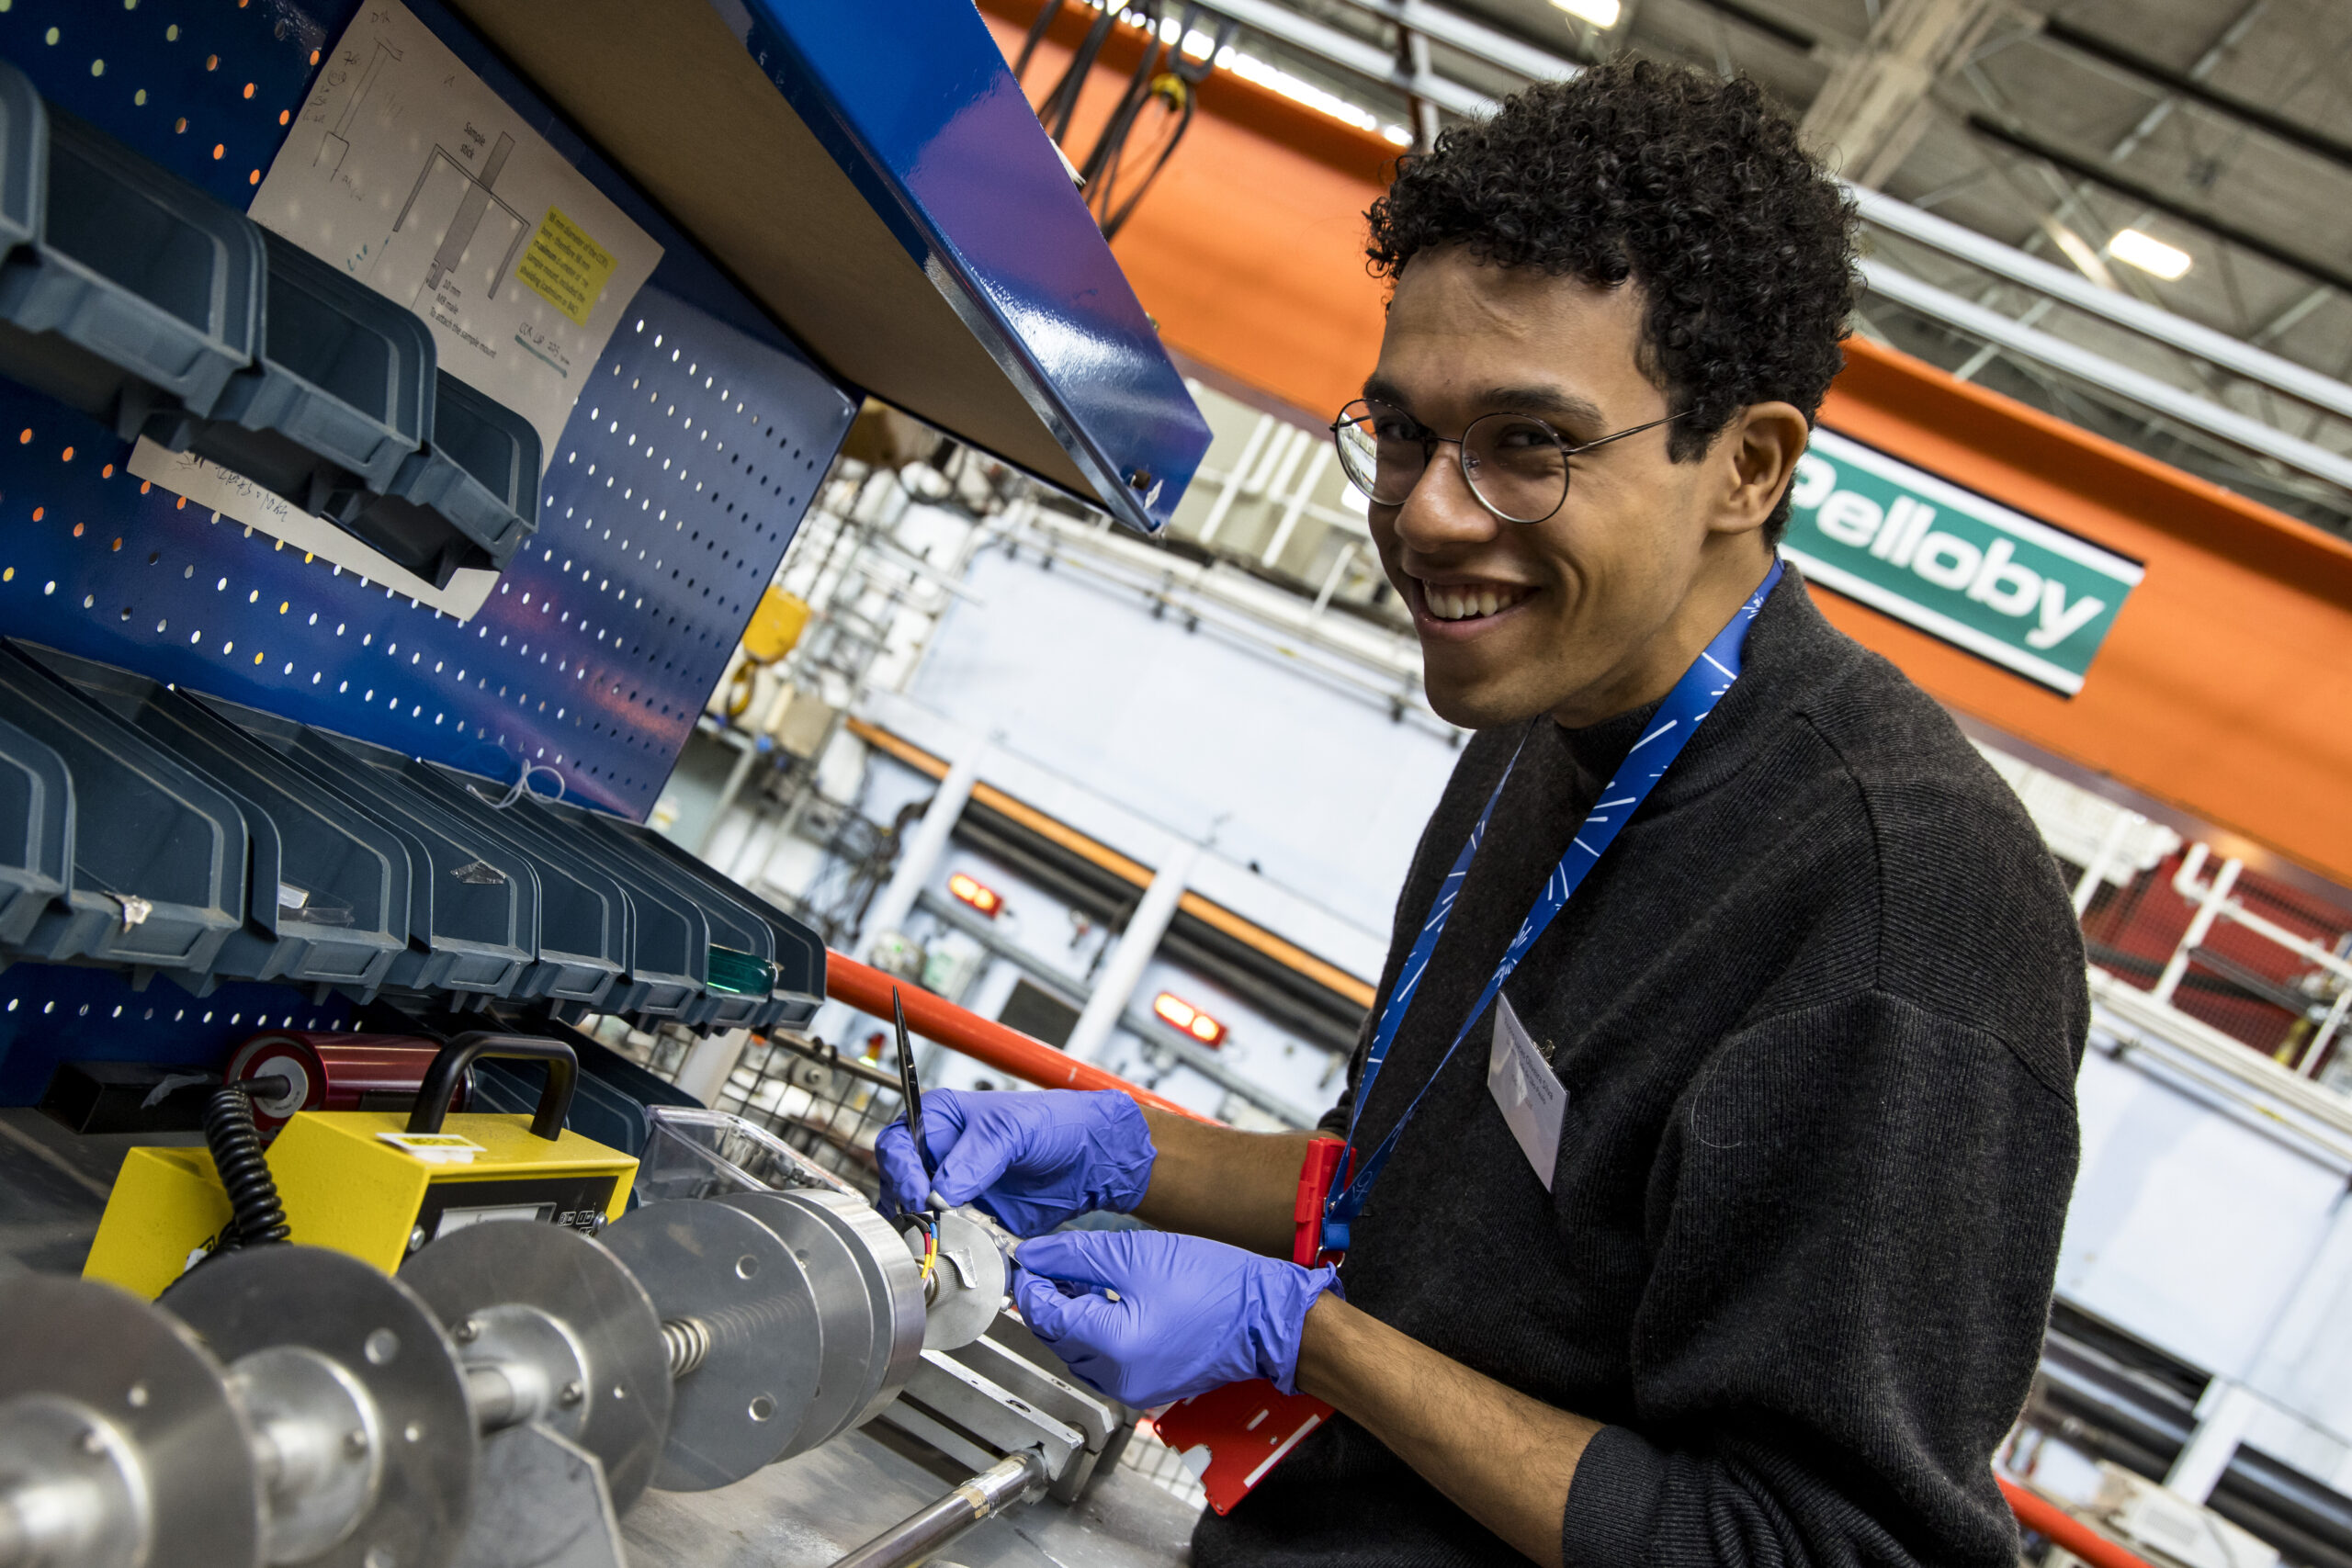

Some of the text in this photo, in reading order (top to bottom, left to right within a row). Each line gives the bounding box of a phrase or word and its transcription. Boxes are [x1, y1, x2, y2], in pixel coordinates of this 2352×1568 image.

[463, 121, 487, 148] Sample
[459, 141, 477, 162] stick
[450, 287, 460, 296] mm
[435, 314, 452, 327] attach
[452, 323, 460, 334] the
[460, 332, 479, 347] sample
[480, 344, 496, 358] mount
